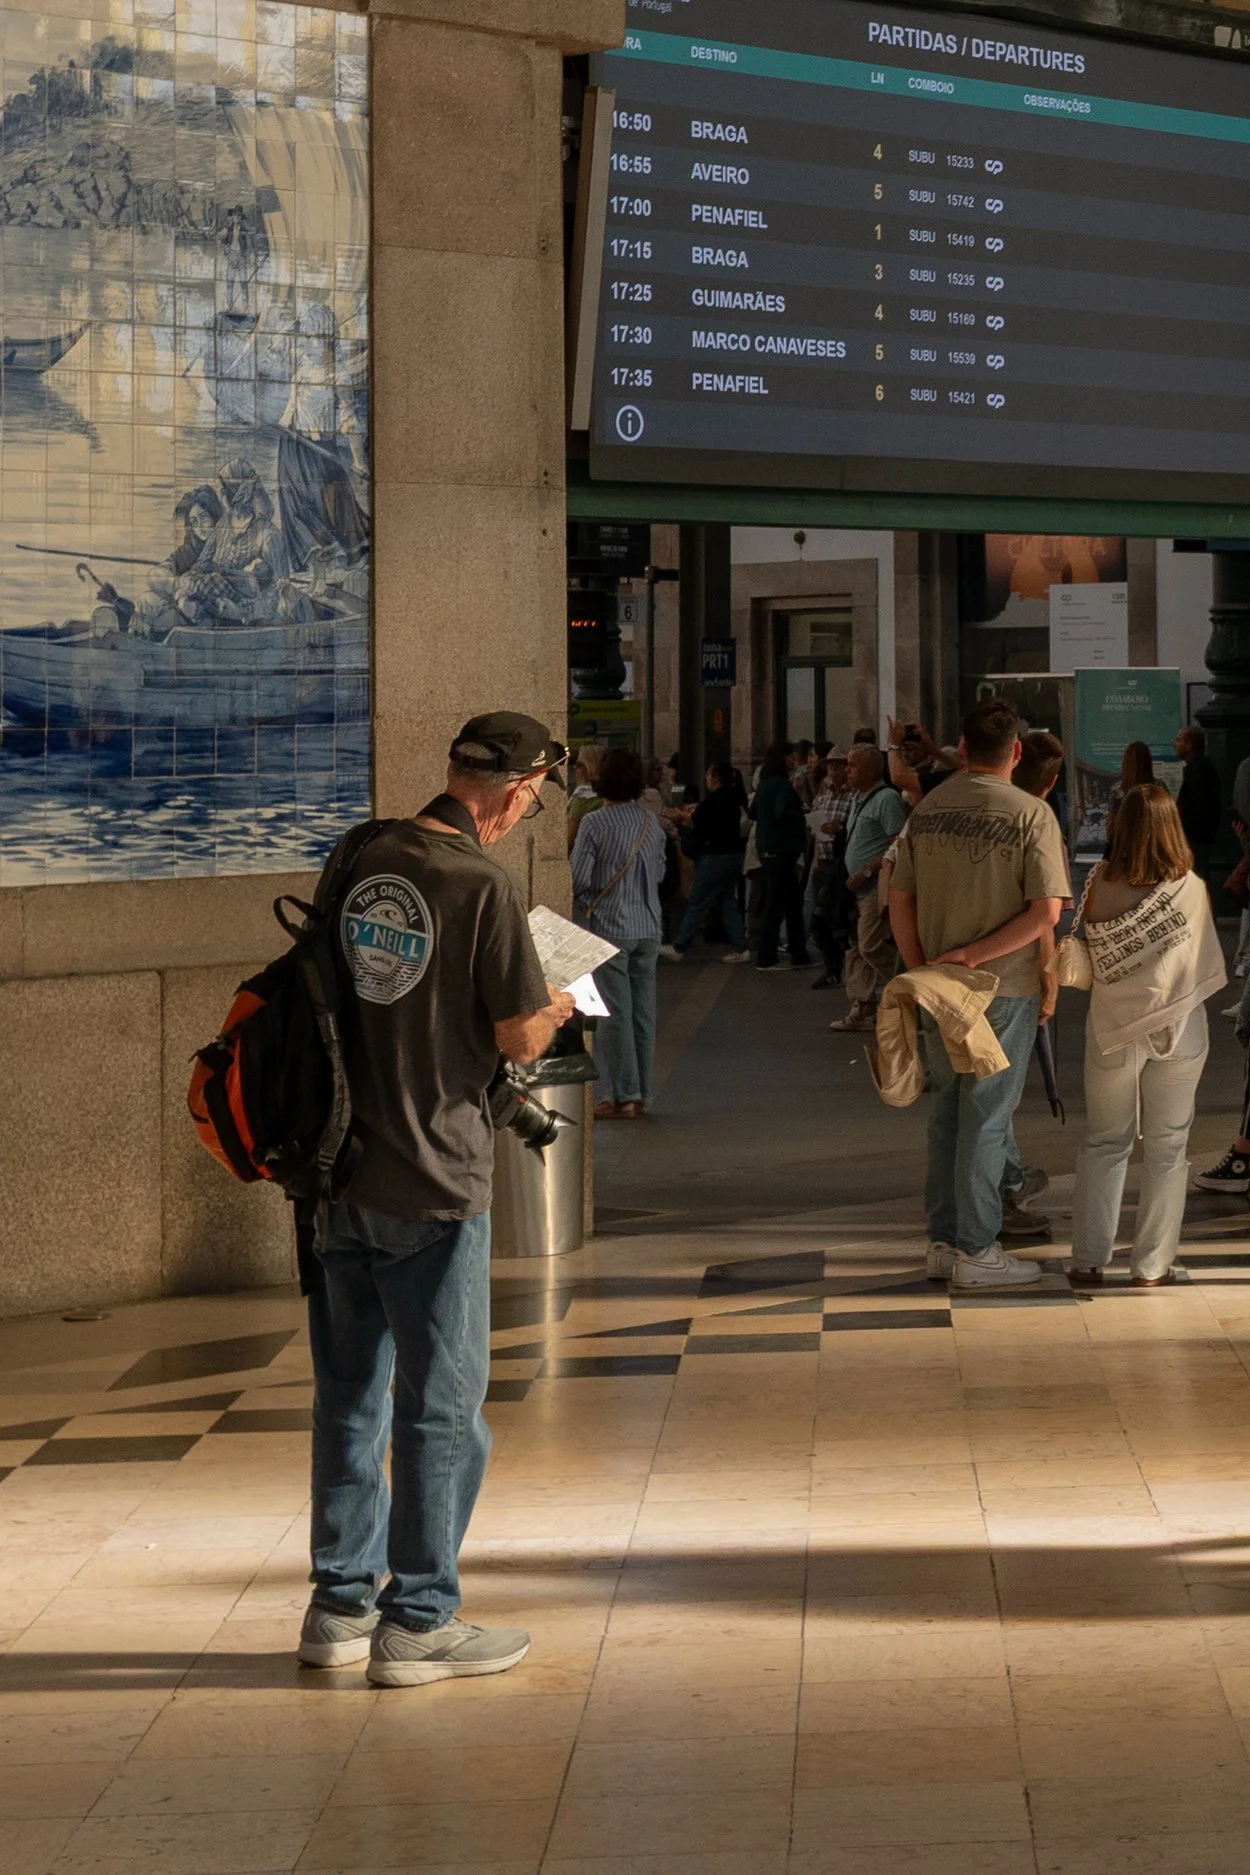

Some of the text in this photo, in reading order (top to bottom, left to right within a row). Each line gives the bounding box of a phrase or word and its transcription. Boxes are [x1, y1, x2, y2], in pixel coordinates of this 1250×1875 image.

[869, 23, 1084, 73] PARTIDAS / DEPARTURES
[691, 46, 737, 63] DESTINO
[872, 72, 884, 84] LN
[909, 78, 954, 94] COMBOIO
[1024, 94, 1090, 113] OBSERVAÇÕES
[613, 111, 651, 131] 16:50
[692, 121, 748, 143] BRAGA
[874, 144, 882, 159] 4
[909, 150, 935, 163] SUBU
[947, 155, 973, 168] 15233
[611, 154, 651, 173] 16:55
[691, 163, 749, 184] AVEIRO
[875, 184, 882, 199] 5
[909, 190, 935, 203] SUBU
[947, 195, 974, 207] 15742
[611, 196, 651, 216] 17:00
[692, 205, 767, 228] PENAFIEL
[875, 224, 880, 239] 1
[910, 229, 935, 242] SUBU
[948, 234, 974, 246] 15419
[611, 239, 651, 258] 17:15
[692, 247, 748, 267] BRAGA
[875, 264, 882, 279] 3
[910, 269, 935, 282] SUBU
[948, 273, 975, 286] 15235
[611, 282, 651, 301] 17:25
[692, 289, 785, 312] GUIMARÃES
[875, 305, 883, 320] 4
[910, 309, 936, 322] SUBU
[948, 313, 975, 325] 15169
[611, 325, 651, 344] 17:30
[693, 331, 750, 351] MARCO
[755, 336, 845, 357] CANAVESES
[876, 345, 883, 360] 5
[911, 349, 936, 361] SUBU
[948, 352, 975, 364] 15539
[612, 368, 652, 386] 17:35
[693, 373, 768, 393] PENAFIEL
[876, 385, 883, 400] 6
[911, 389, 936, 401] SUBU
[949, 392, 974, 403] 15421
[625, 606, 632, 619] 6
[702, 653, 728, 669] PRT1
[356, 885, 419, 924] THE ORIGINAL
[348, 922, 418, 958] O'NEILL
[1097, 937, 1144, 973] FEELINGS
[1146, 912, 1187, 943] BEHIND
